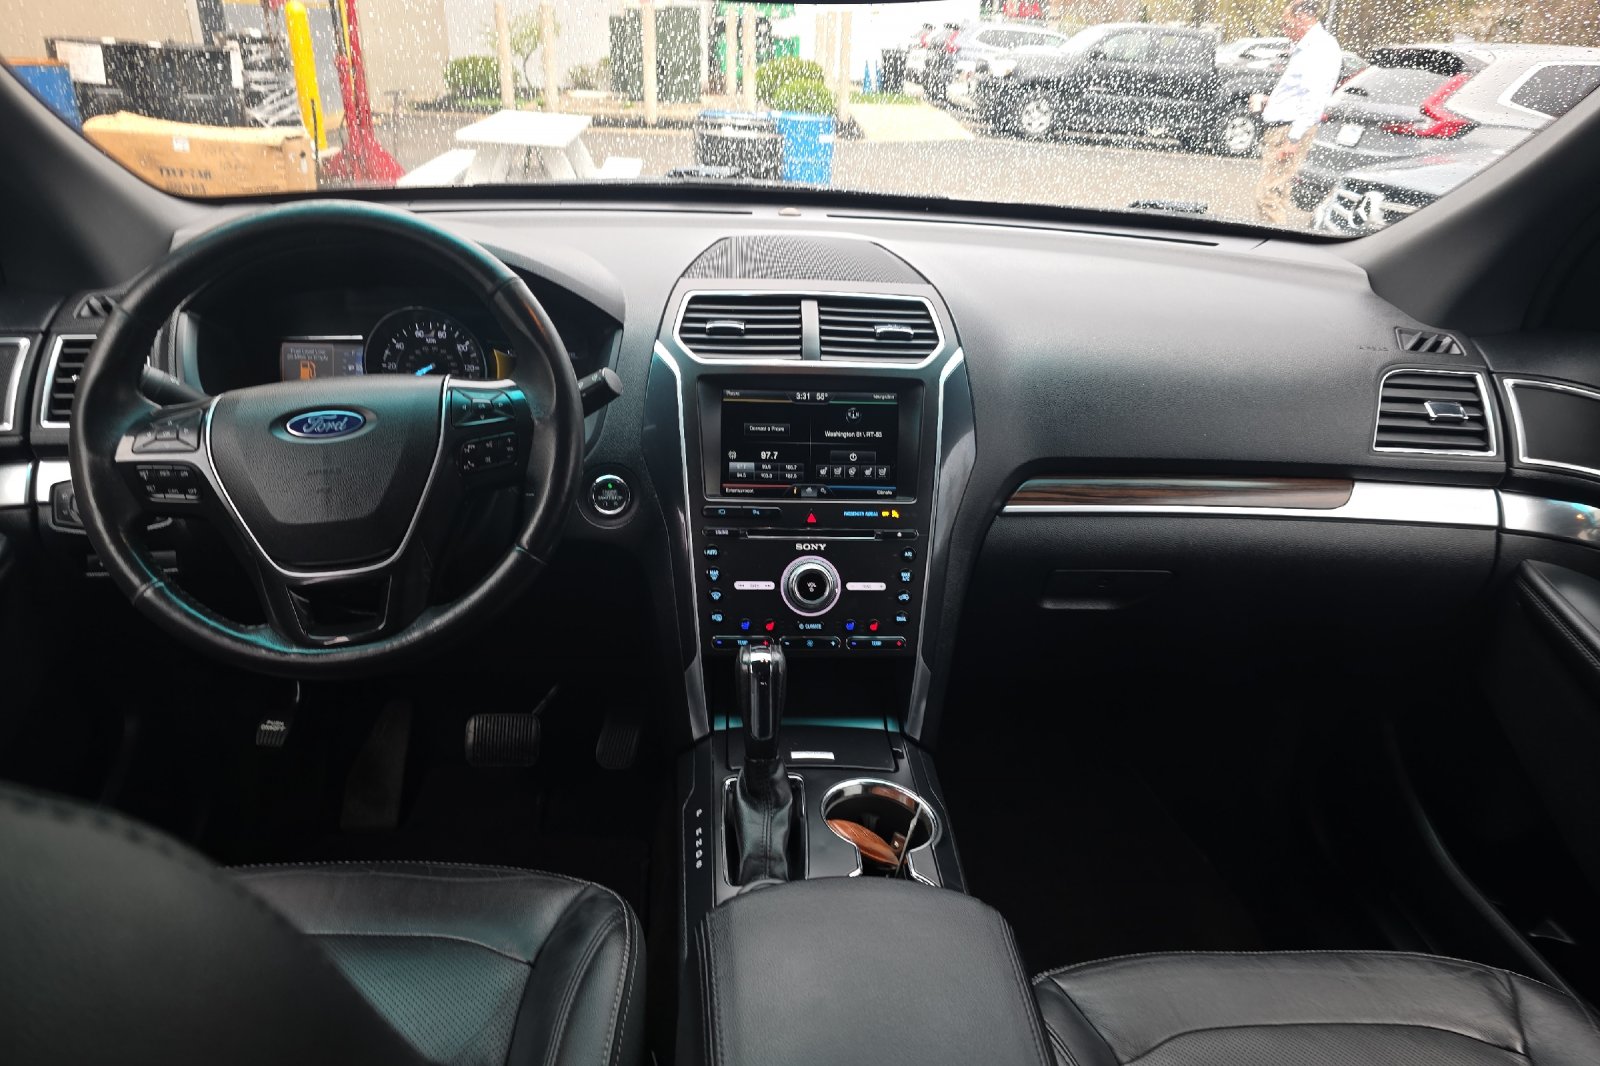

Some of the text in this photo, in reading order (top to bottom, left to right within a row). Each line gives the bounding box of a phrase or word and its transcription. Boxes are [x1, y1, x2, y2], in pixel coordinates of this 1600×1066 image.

[457, 343, 468, 352] 100
[795, 392, 810, 400] 3:31
[303, 414, 348, 433] Ford
[824, 430, 855, 439] Washington
[760, 450, 779, 460] 97.7
[795, 543, 827, 551] SONY
